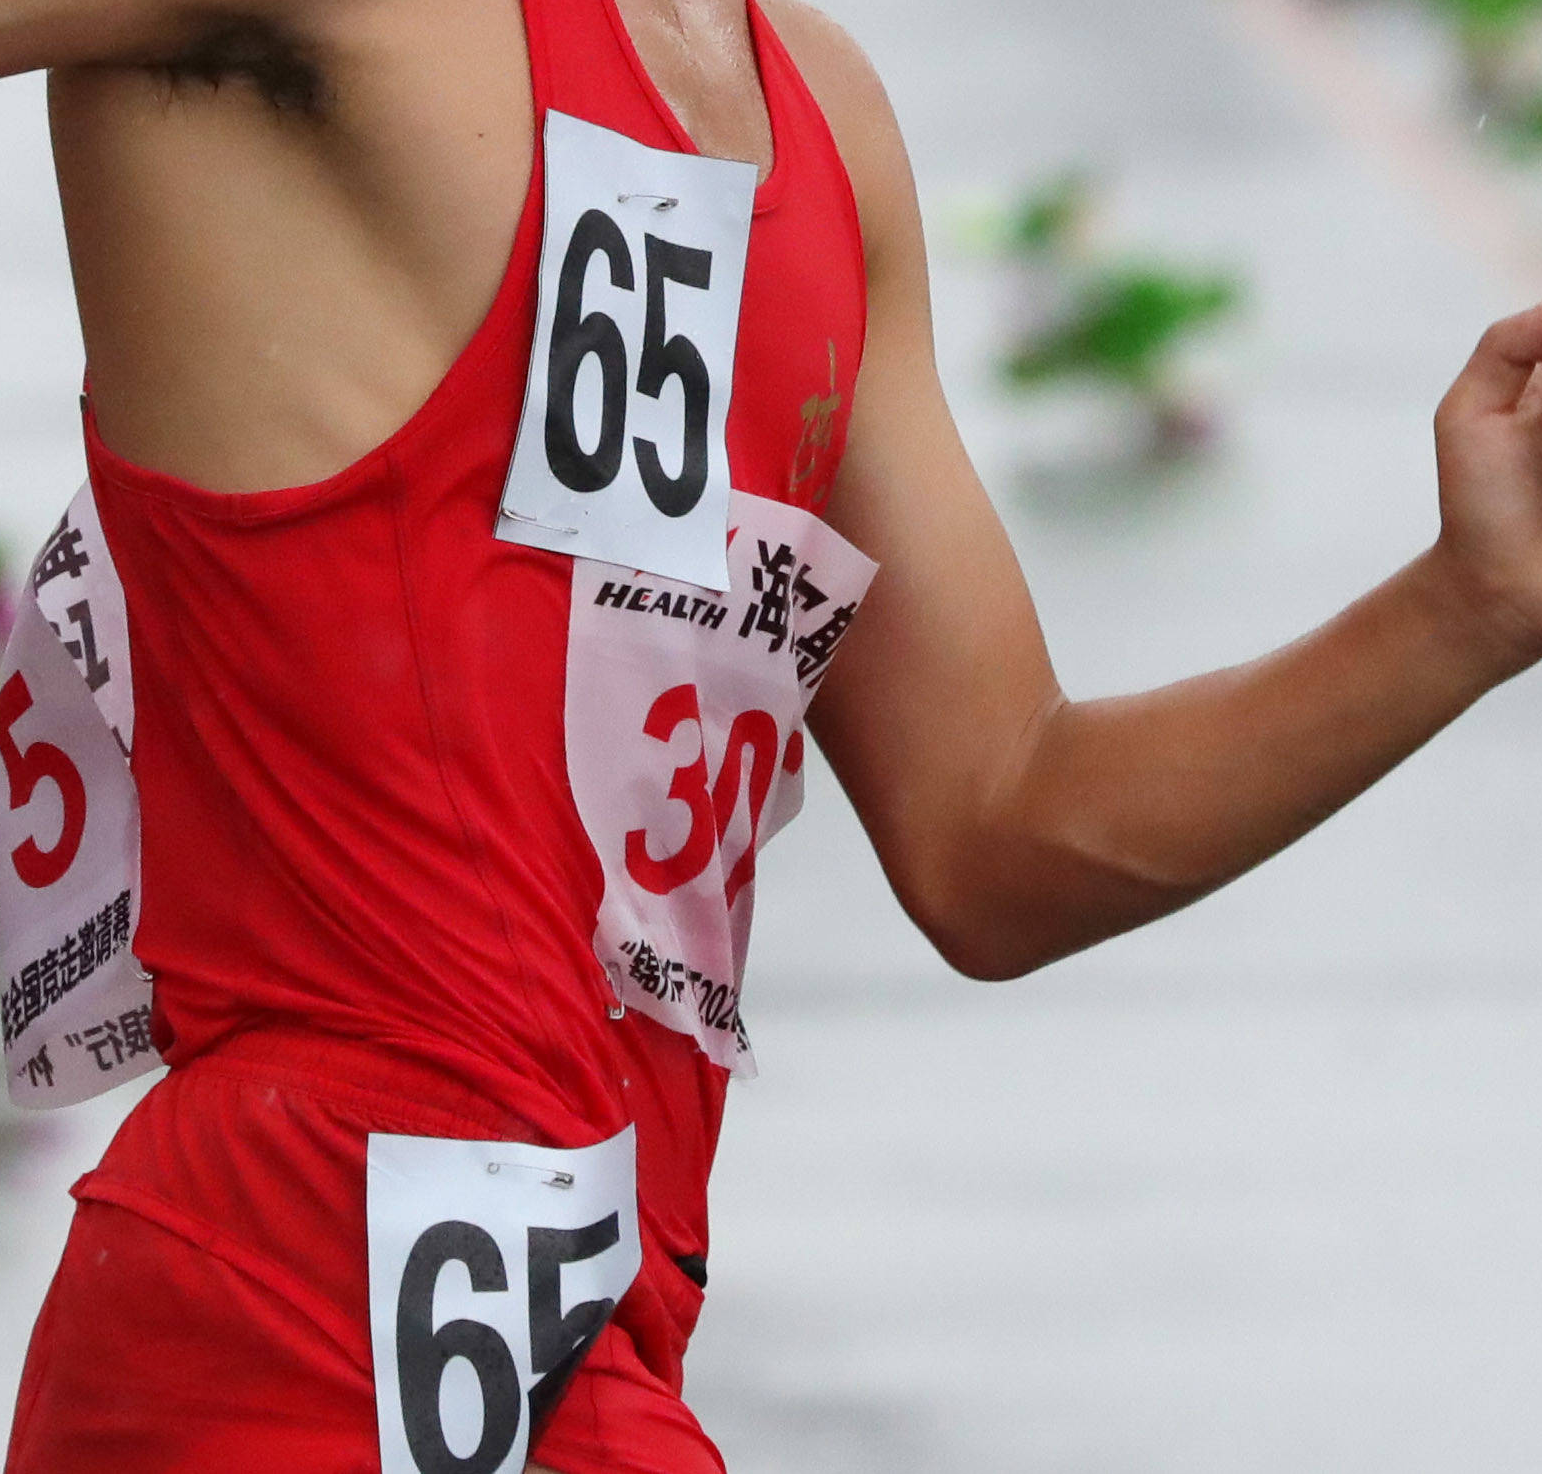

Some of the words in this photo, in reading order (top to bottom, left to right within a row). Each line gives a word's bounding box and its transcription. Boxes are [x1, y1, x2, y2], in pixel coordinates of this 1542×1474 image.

[544, 208, 714, 519] 65
[594, 581, 729, 631] HEALTH
[624, 683, 805, 912] 30
[396, 1210, 621, 1474] 65
